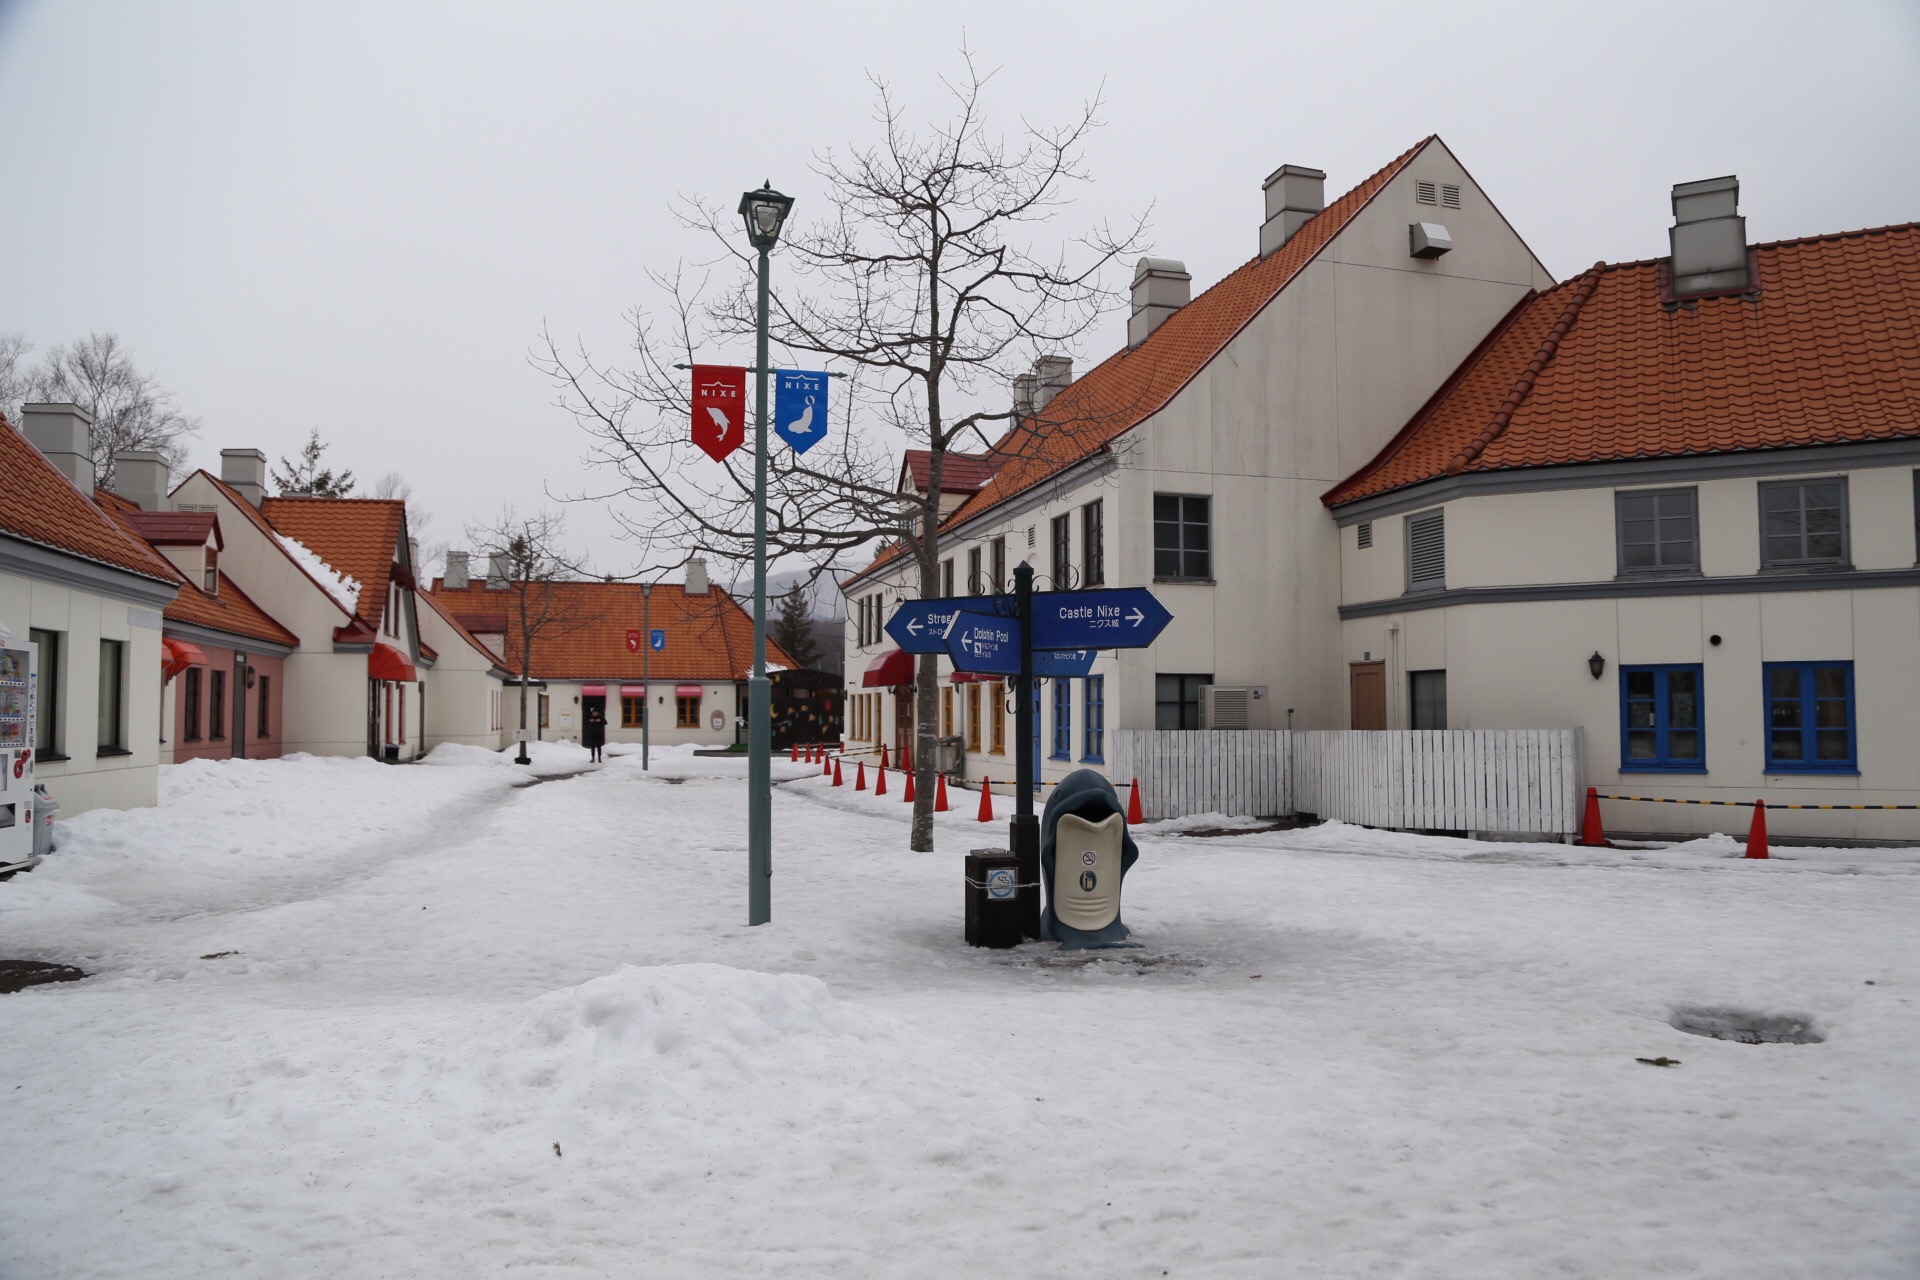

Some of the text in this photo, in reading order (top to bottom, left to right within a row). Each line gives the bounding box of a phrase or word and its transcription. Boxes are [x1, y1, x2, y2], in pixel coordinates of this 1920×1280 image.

[785, 381, 820, 391] NIXE
[701, 389, 736, 398] NIXE
[1059, 605, 1121, 619] Castle Nixe
[974, 627, 1009, 643] Dolphin Pool
